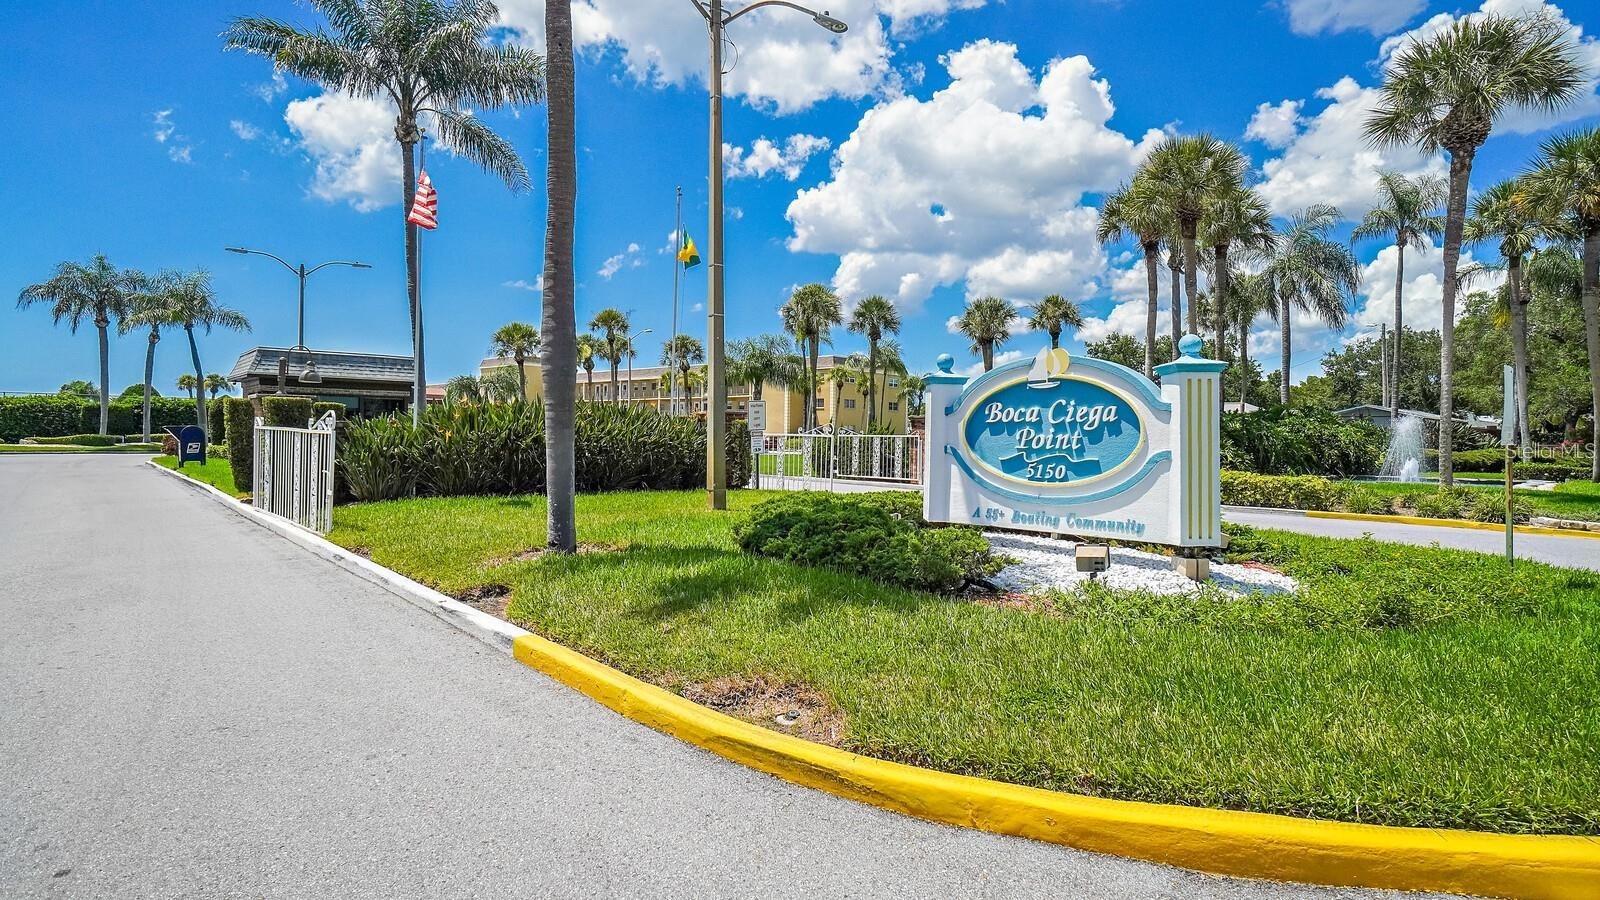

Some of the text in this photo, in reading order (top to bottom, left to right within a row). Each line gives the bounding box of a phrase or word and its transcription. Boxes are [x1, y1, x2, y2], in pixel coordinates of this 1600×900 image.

[985, 399, 1118, 430] Boca Ciega
[1015, 428, 1082, 449] Point
[1026, 463, 1066, 479] 5150
[972, 507, 1146, 537] A 55+ Boating Community
